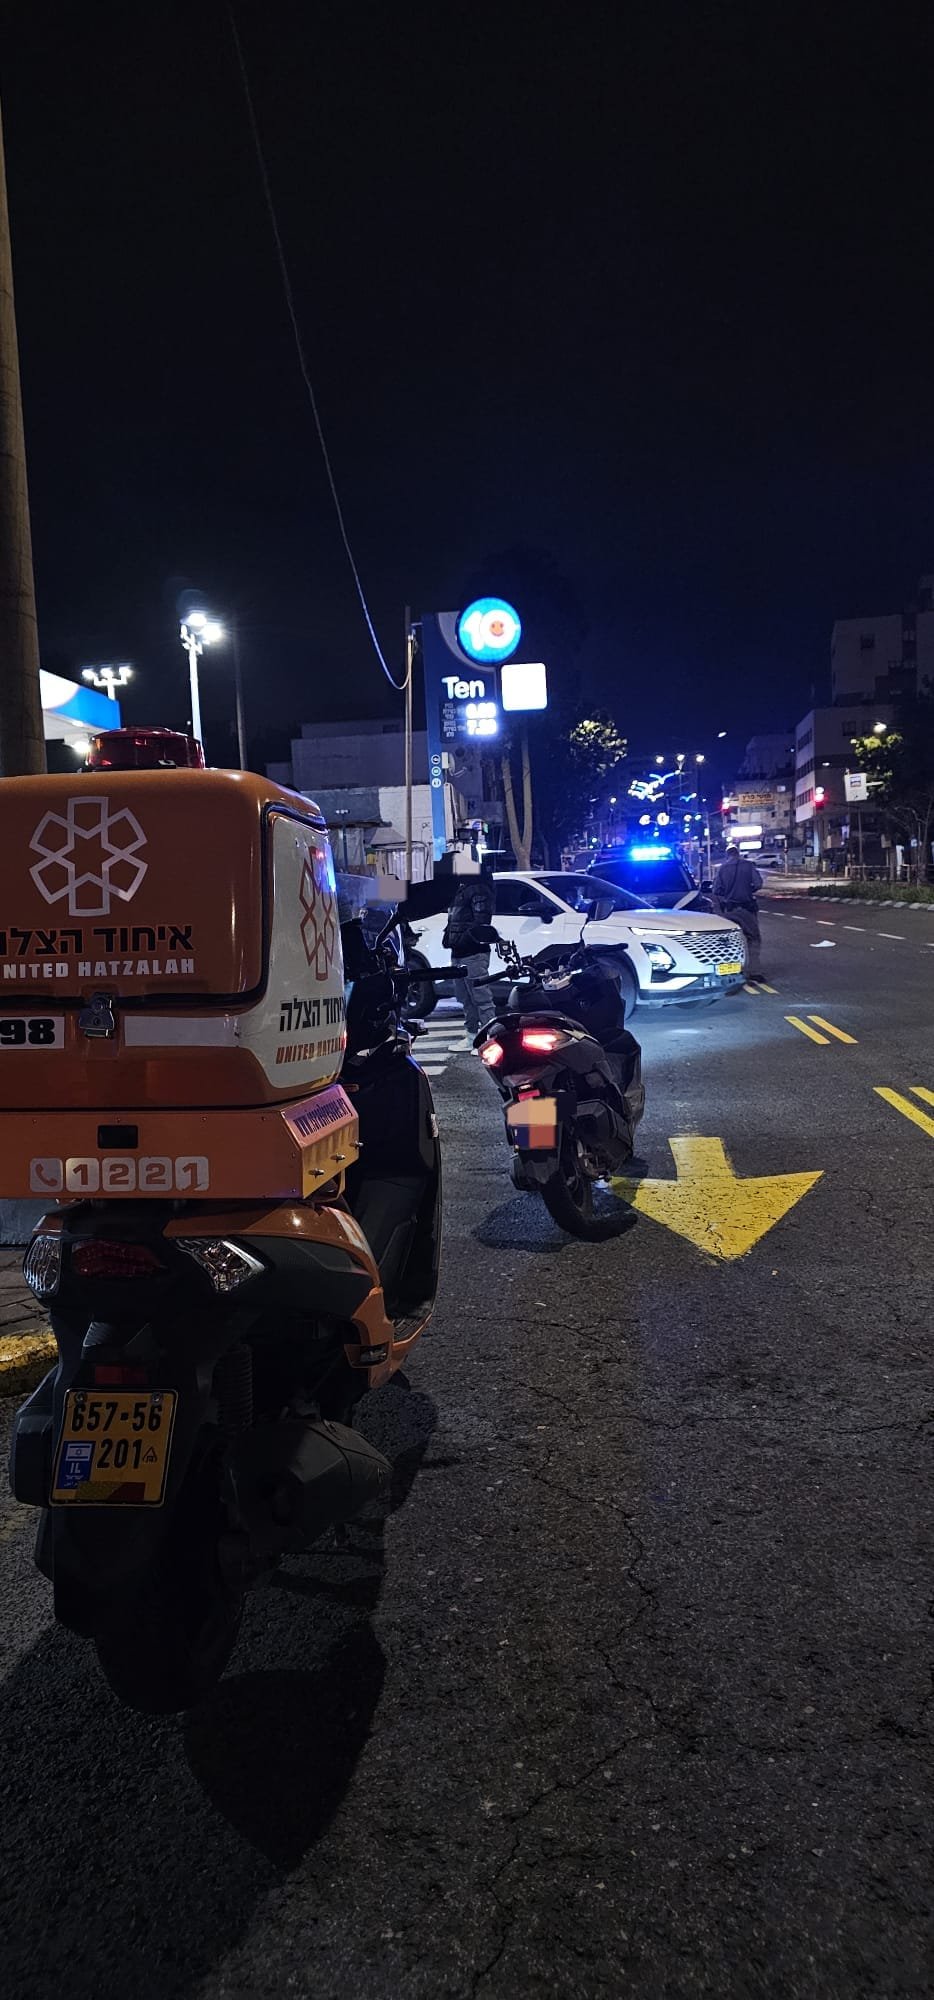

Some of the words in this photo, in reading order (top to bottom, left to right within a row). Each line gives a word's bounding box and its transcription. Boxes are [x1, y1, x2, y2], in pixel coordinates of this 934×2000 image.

[441, 676, 485, 699] Ten
[0, 927, 84, 956] הצל
[93, 925, 194, 953] איחוד
[3, 962, 69, 979] NITED
[78, 958, 195, 977] HATZALAH
[280, 998, 320, 1031] הצלה
[0, 1019, 56, 1045] 98
[276, 1043, 314, 1064] UNITED
[69, 1161, 202, 1191] 1221
[71, 1402, 163, 1432] 657-56
[97, 1439, 143, 1469] 201
[70, 1463, 81, 1474] IL
